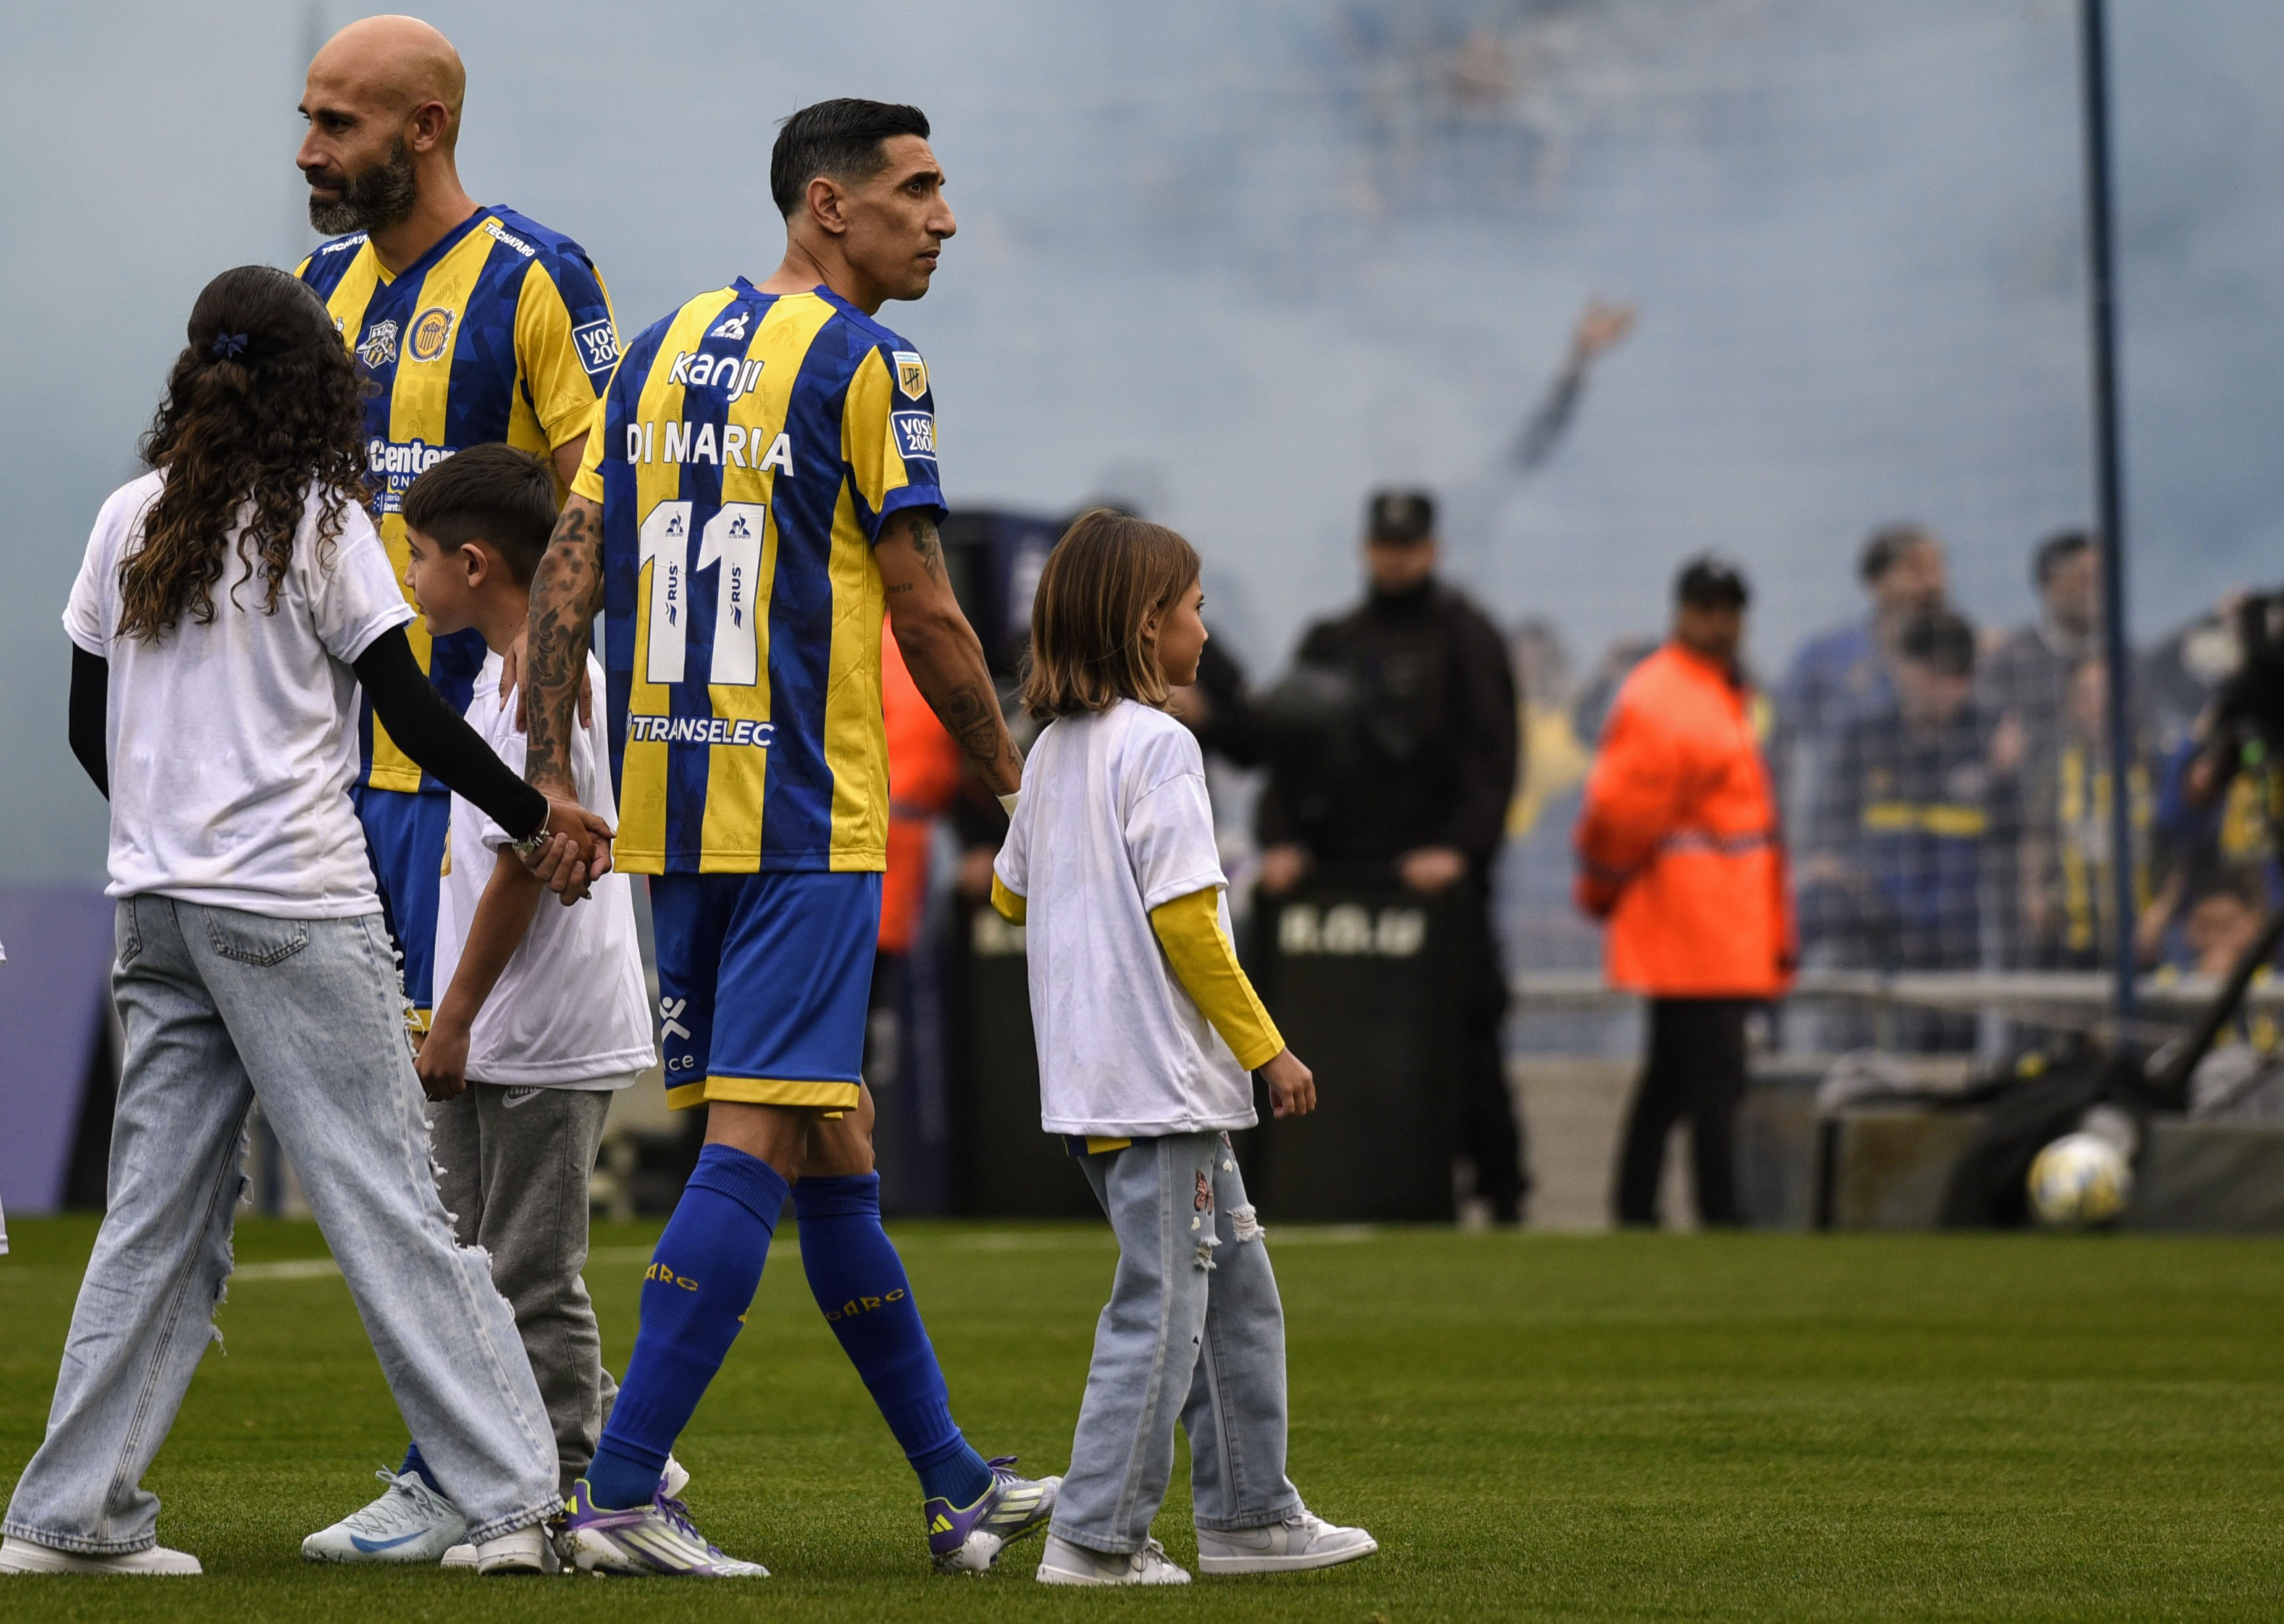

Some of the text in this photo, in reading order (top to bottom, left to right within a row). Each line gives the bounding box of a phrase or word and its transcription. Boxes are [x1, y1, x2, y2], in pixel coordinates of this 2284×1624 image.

[627, 421, 794, 476] DI MARIA
[639, 500, 766, 686] 11
[667, 564, 679, 600] RUS
[731, 566, 742, 602] RUS
[633, 717, 775, 746] TRANSELEC
